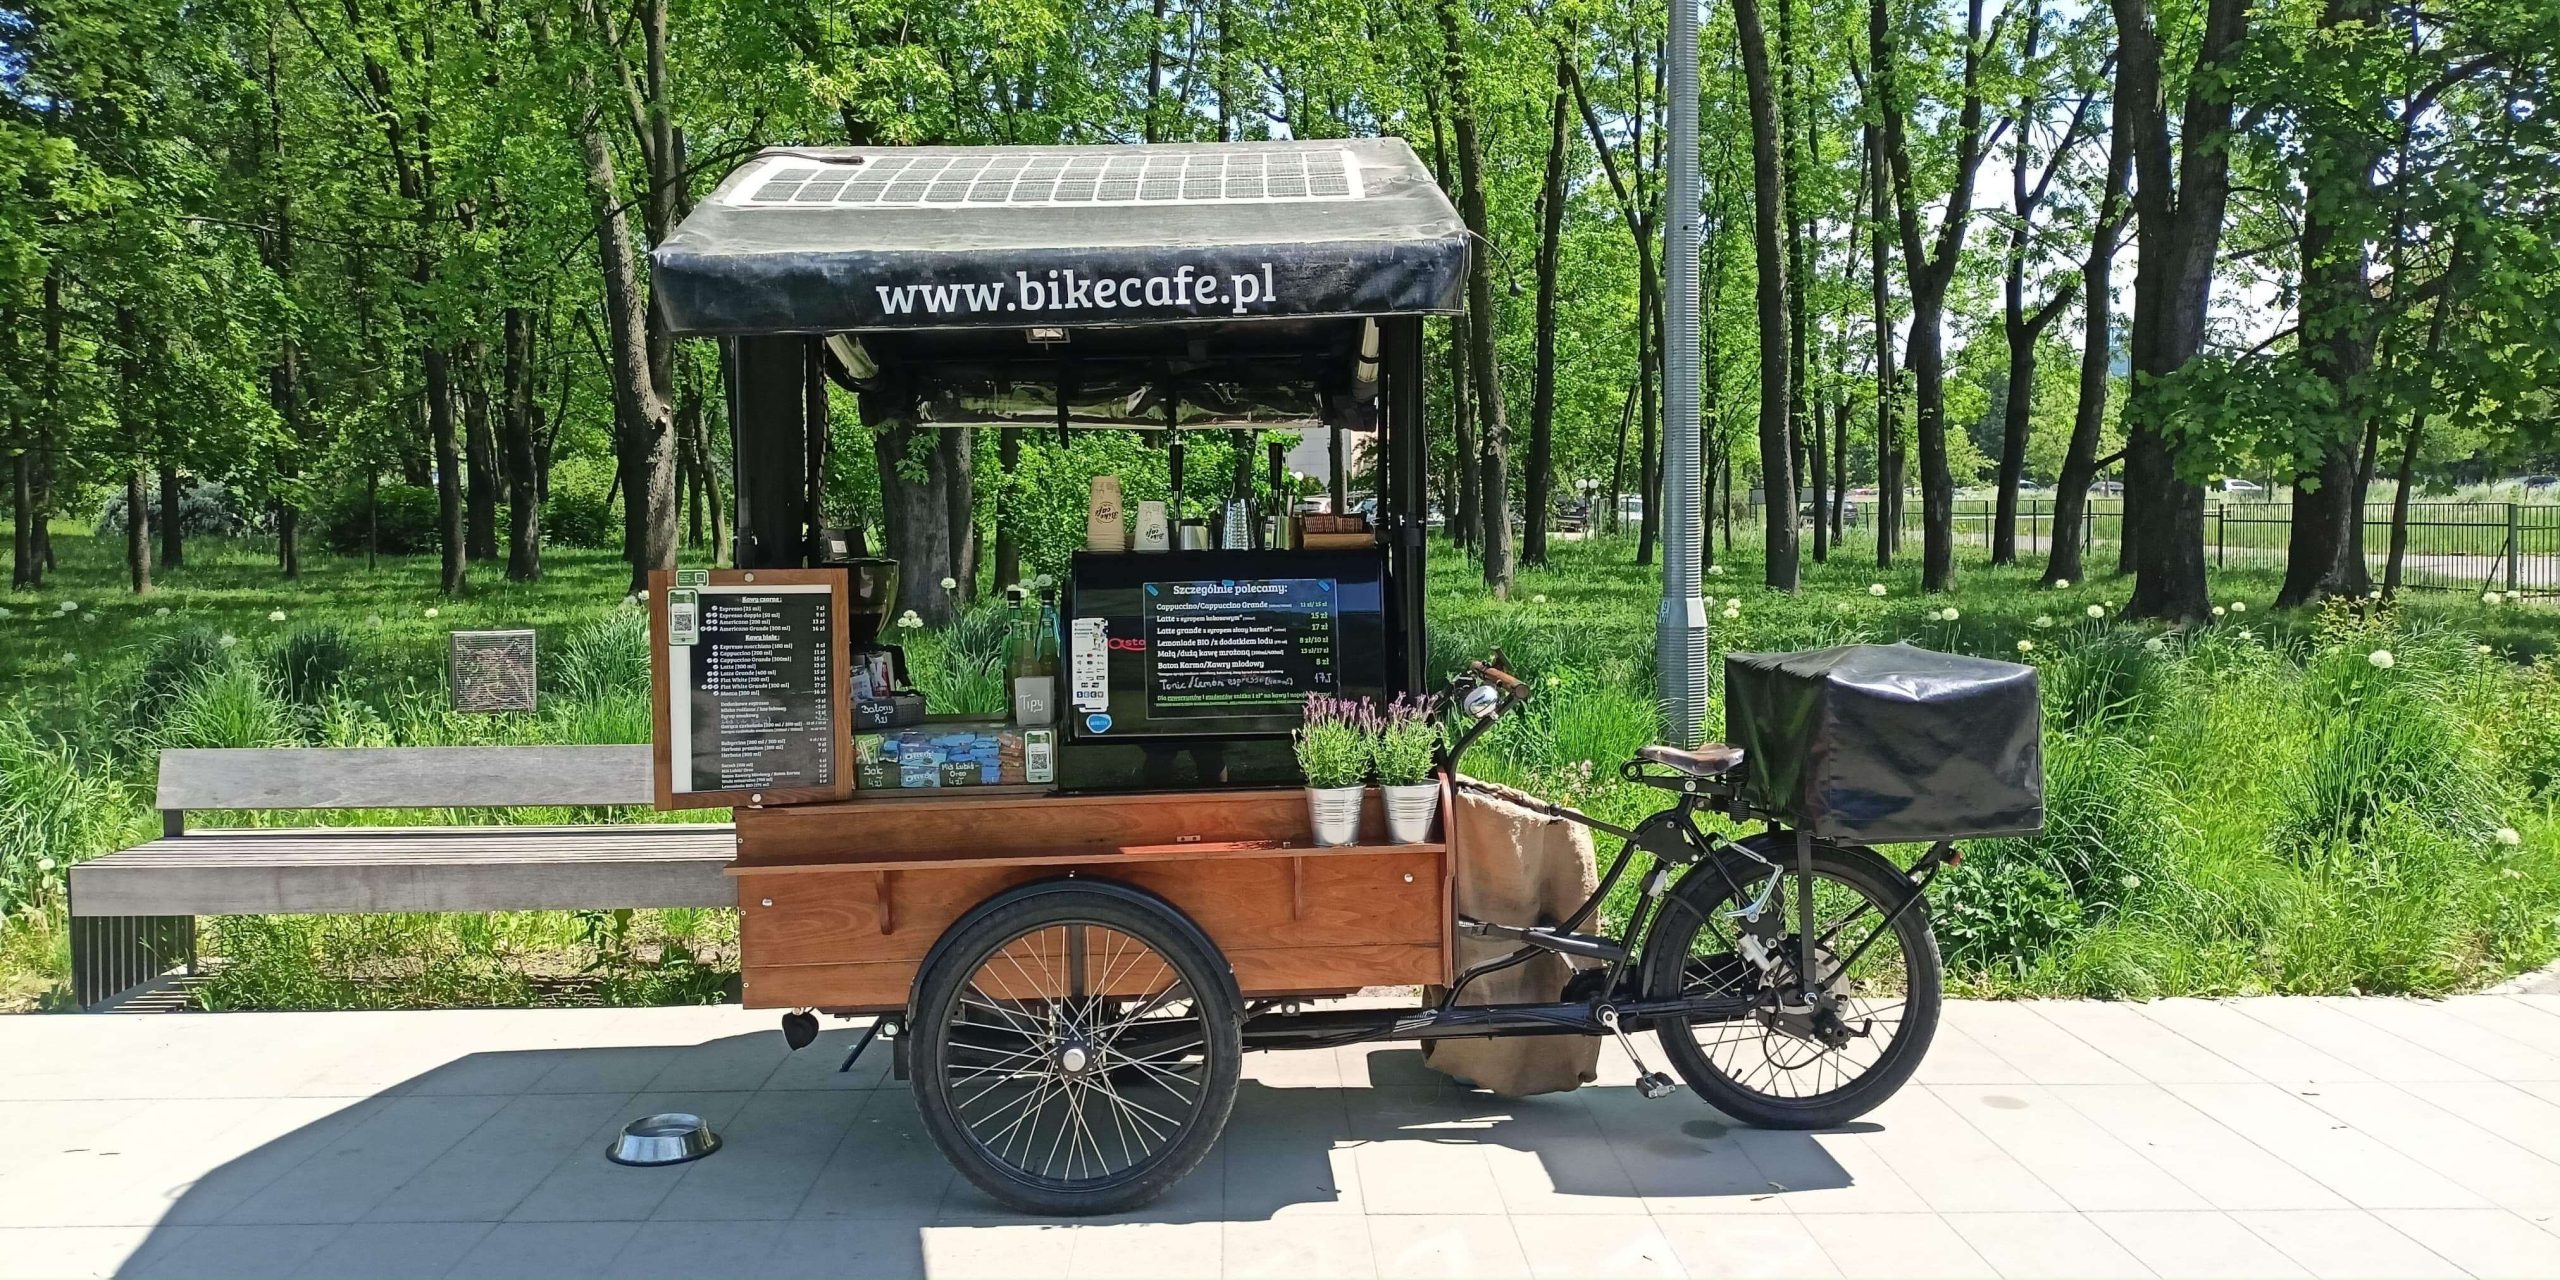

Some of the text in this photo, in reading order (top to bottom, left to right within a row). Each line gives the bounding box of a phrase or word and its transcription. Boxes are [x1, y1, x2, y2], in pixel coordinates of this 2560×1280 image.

[876, 263, 1276, 314] www.bikecafe.pl
[1173, 584, 1288, 596] Szczególnie polecamy:
[1176, 627, 1201, 635] grande
[1020, 694, 1044, 712] Tipy
[864, 766, 883, 775] Sok
